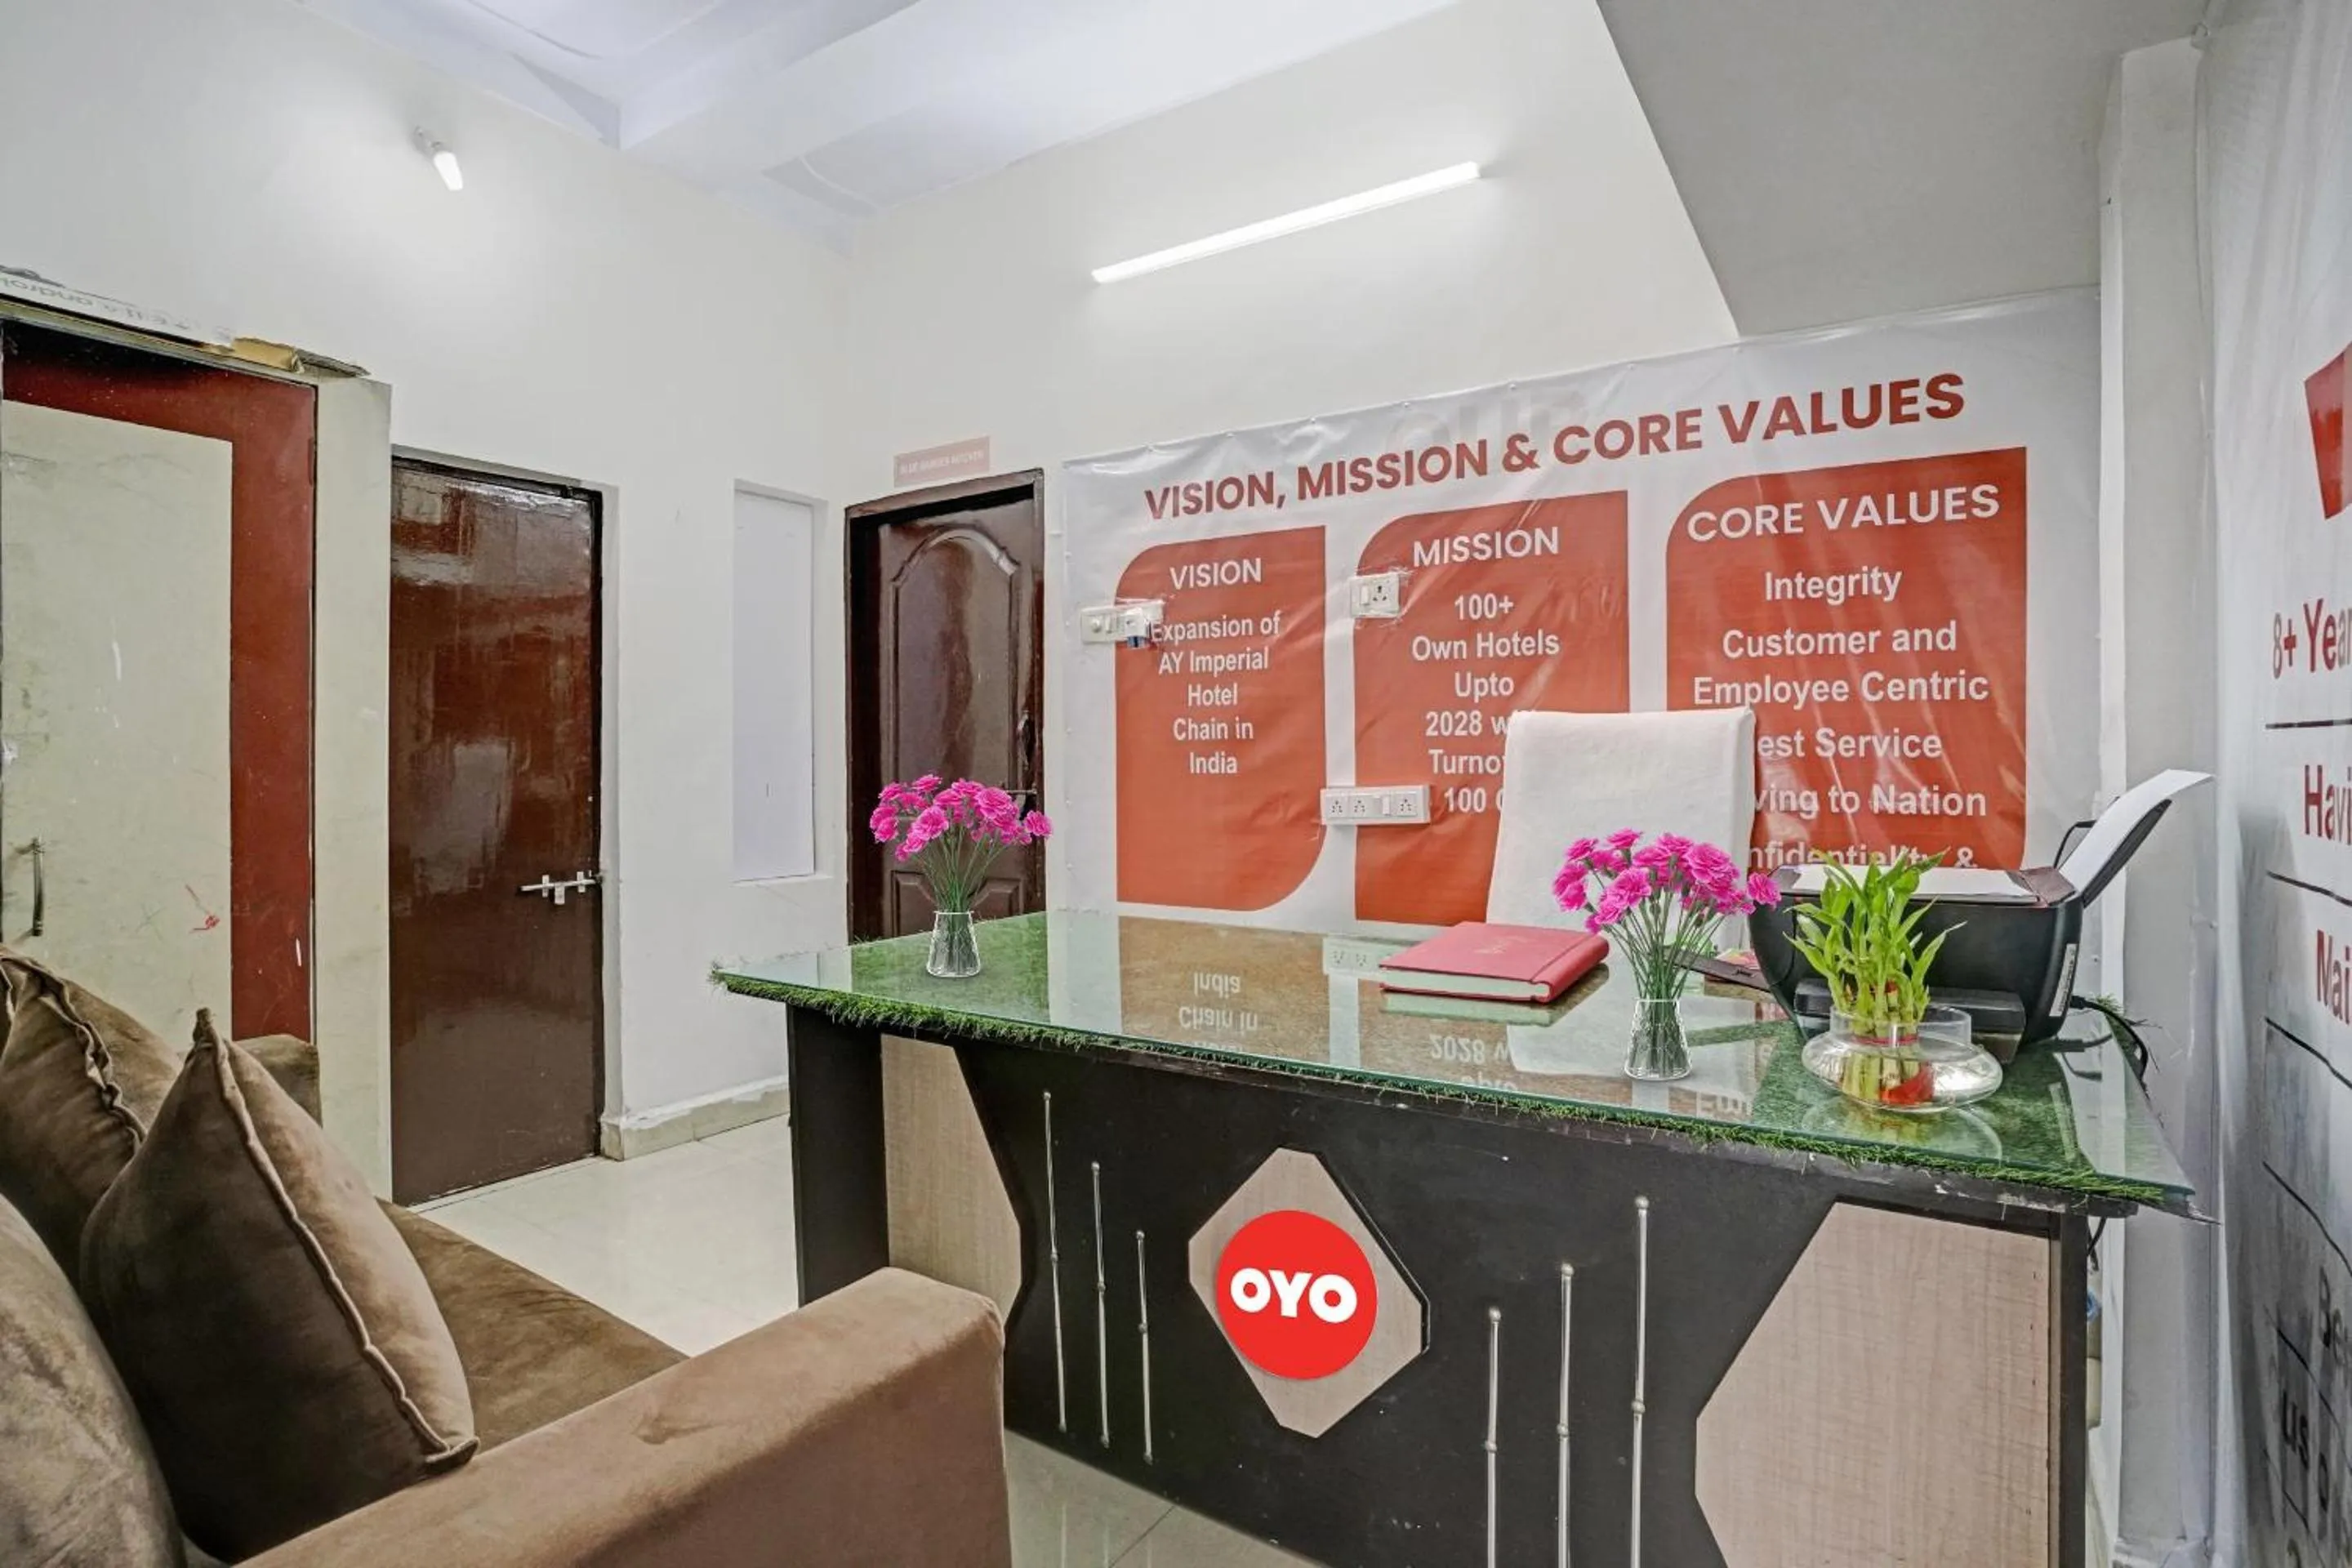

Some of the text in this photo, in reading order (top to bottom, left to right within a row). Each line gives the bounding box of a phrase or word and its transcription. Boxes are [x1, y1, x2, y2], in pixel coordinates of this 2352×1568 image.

[1144, 471, 1285, 520] VISION,
[1298, 438, 1488, 501] MISSION
[1502, 433, 1541, 472] &
[1553, 408, 1704, 465] CORE
[1718, 372, 1965, 443] VALUES
[1687, 483, 2000, 541] CORE VALUES
[1413, 526, 1559, 568] MISSION
[1169, 558, 1263, 590] VISION
[1765, 565, 1903, 605] Integrity
[1454, 594, 1514, 620] 100+
[1152, 609, 1281, 646] Expansion of
[1722, 621, 1957, 659] Customer and
[1158, 646, 1269, 677] AY Imperial
[1411, 630, 1561, 662] Own Hotels
[2273, 612, 2296, 679] 8+
[1187, 684, 1238, 706] Hotel
[1454, 671, 1515, 702] Upto
[1694, 670, 1989, 713] Employee Centric
[1173, 716, 1254, 740] Chain in
[1425, 710, 1482, 736] 2028
[1757, 727, 1943, 759] est Service
[1189, 751, 1238, 774] India
[1428, 748, 1506, 774] Turno
[1444, 786, 1486, 813] 100
[1756, 783, 1987, 820] ving to Nation
[1230, 1267, 1358, 1324] OYO
